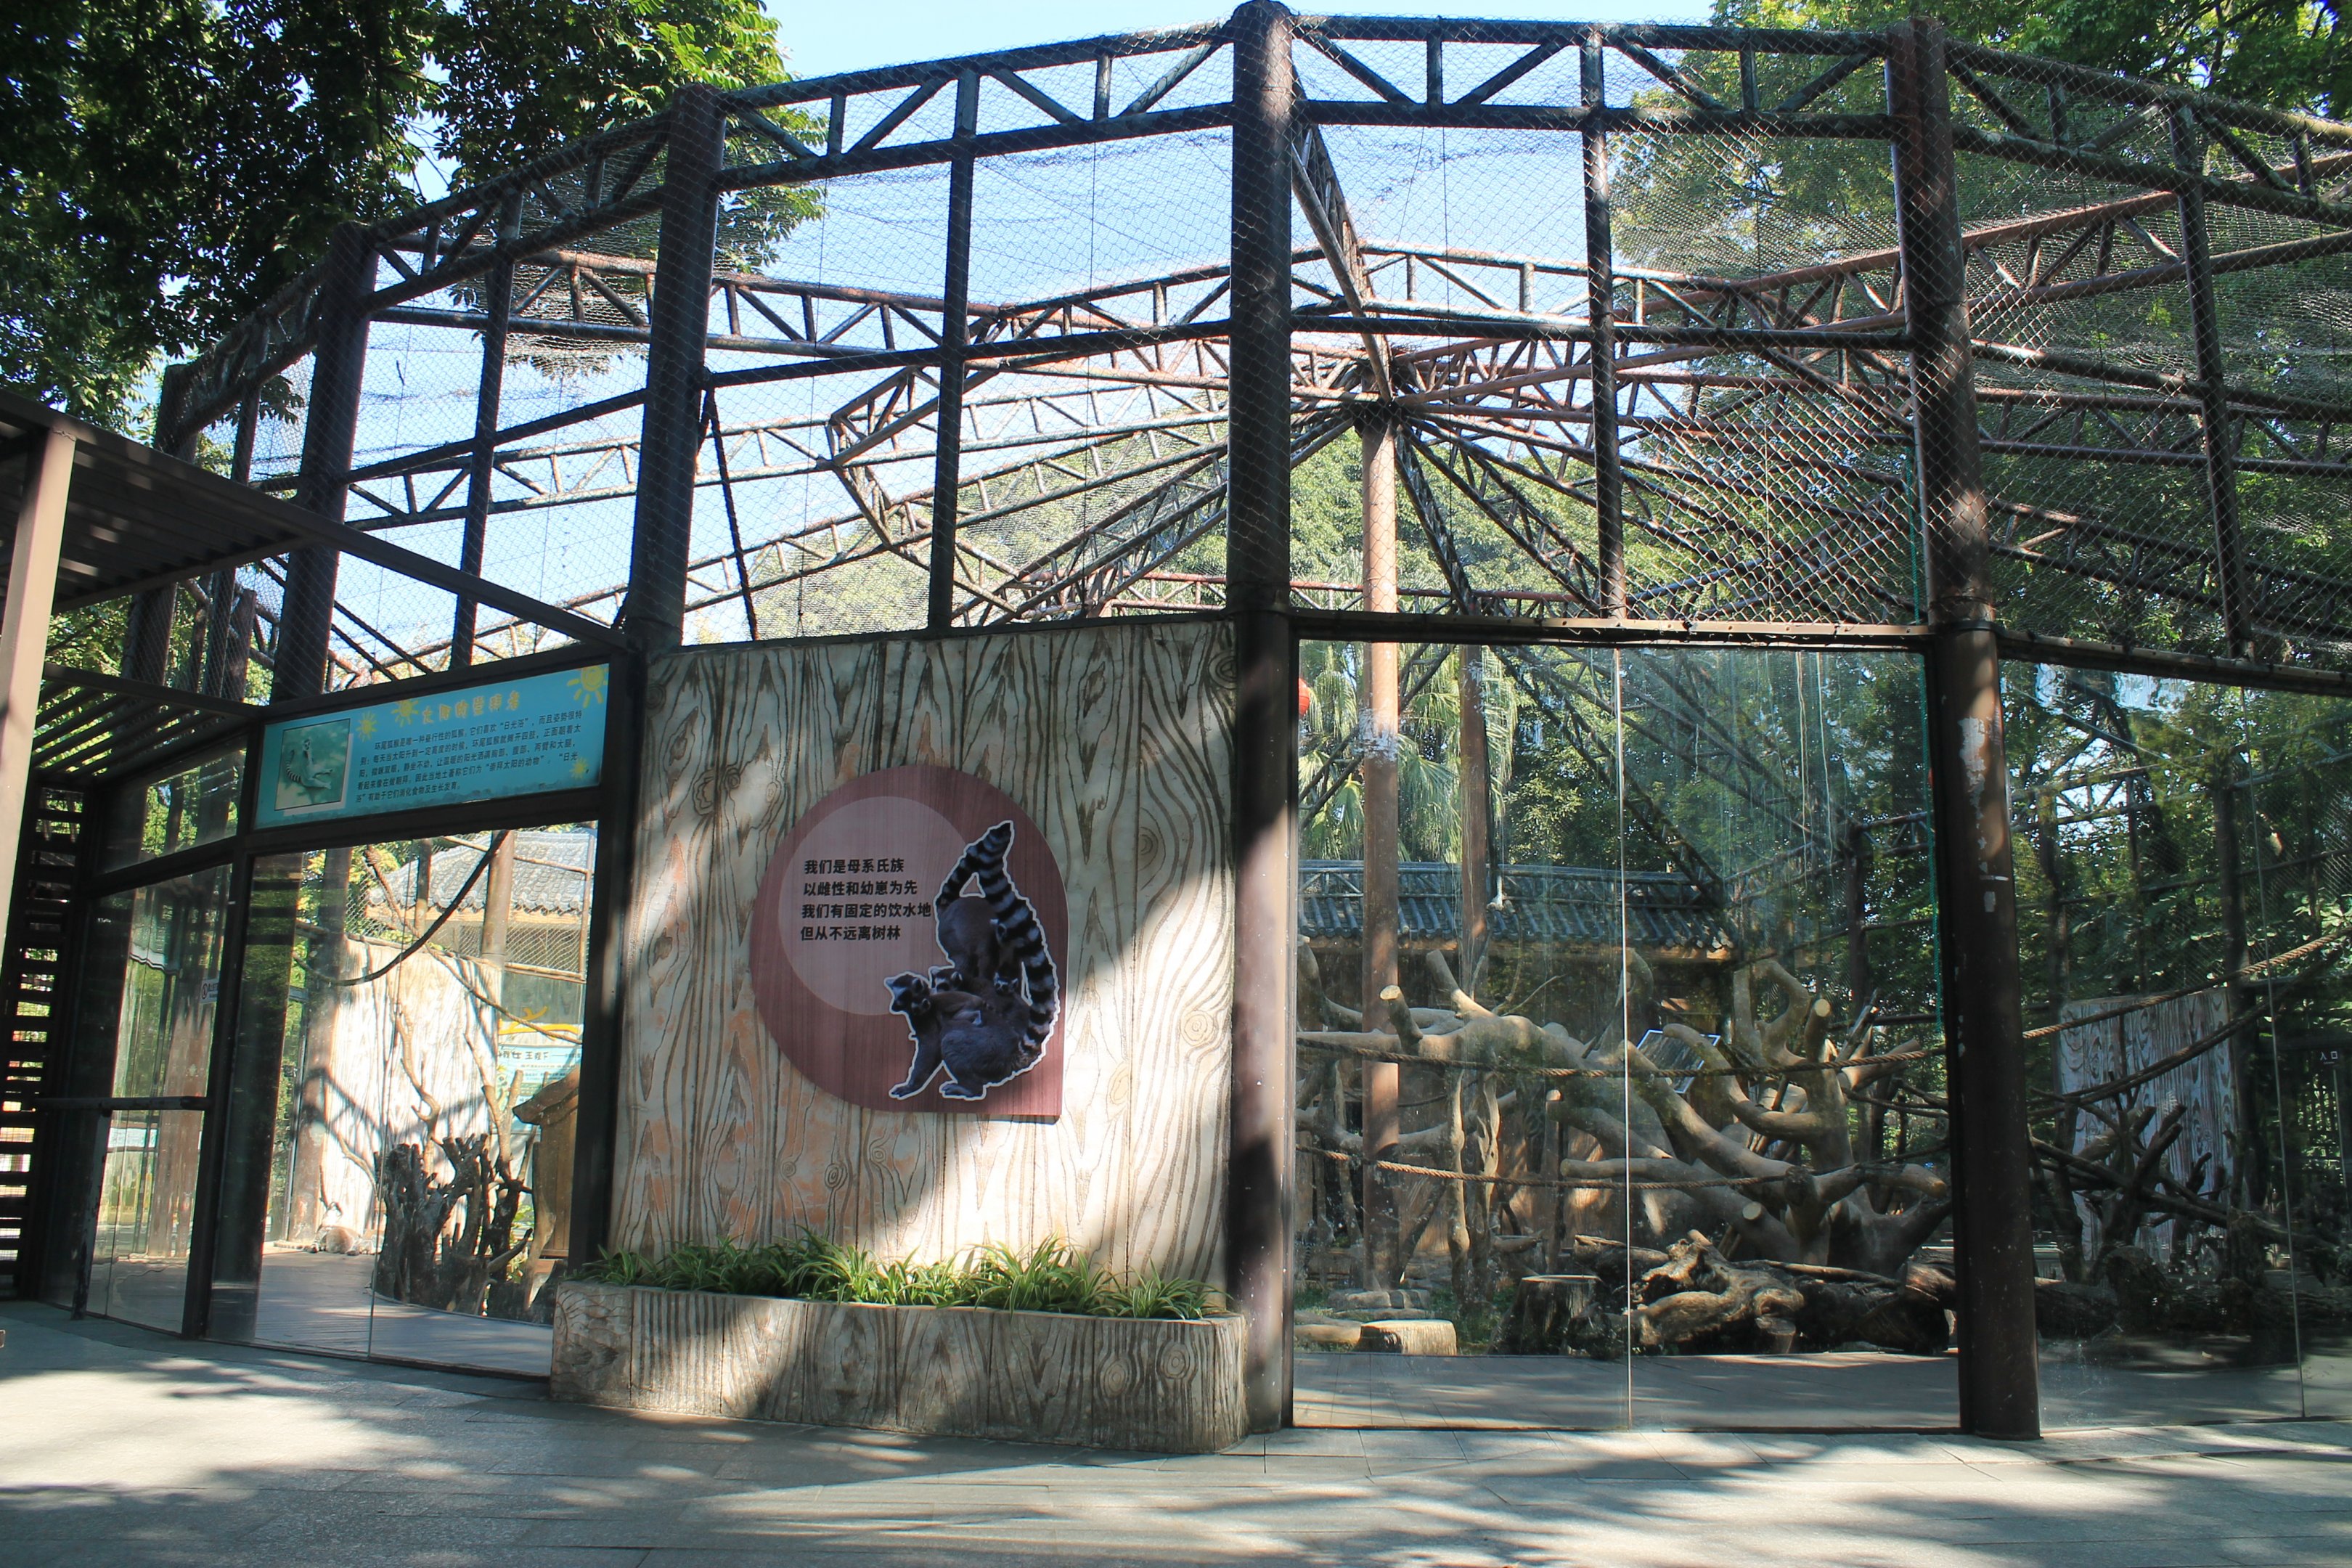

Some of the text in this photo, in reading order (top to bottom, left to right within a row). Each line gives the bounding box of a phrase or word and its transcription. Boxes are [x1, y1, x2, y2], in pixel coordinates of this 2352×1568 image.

[804, 858, 905, 874] 我们是母系氏族
[804, 880, 918, 896] 以雌性和幼崽为先
[801, 902, 931, 918] 我们有固定的饮水地
[801, 926, 901, 941] 但从不远离树林
[2320, 1051, 2338, 1061] 入口
